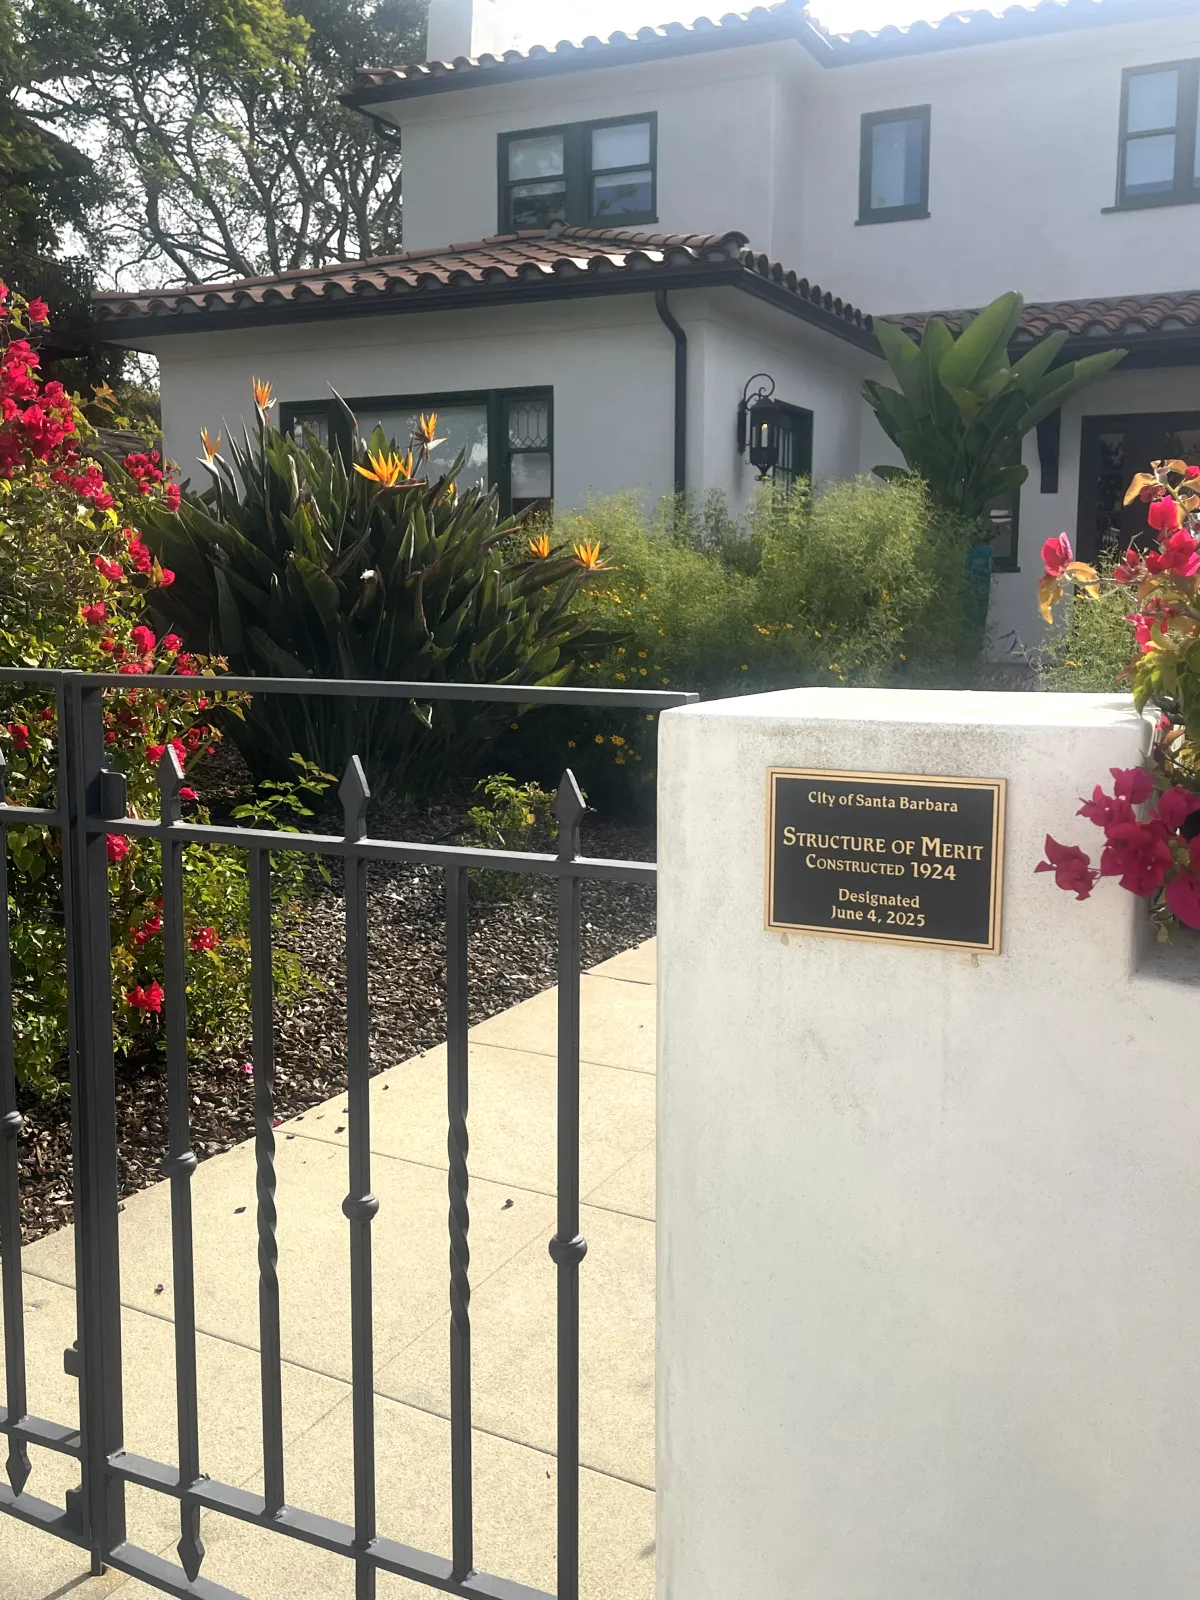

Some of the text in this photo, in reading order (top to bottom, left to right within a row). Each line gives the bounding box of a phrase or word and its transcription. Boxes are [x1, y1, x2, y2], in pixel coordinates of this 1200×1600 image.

[808, 791, 958, 812] City of Santa Barbara
[783, 826, 984, 860] STRUCTURE OF MERIT
[805, 853, 956, 881] CONSTRUCTED 1924
[838, 888, 920, 908] Designated
[831, 905, 926, 927] June 4, 2025
